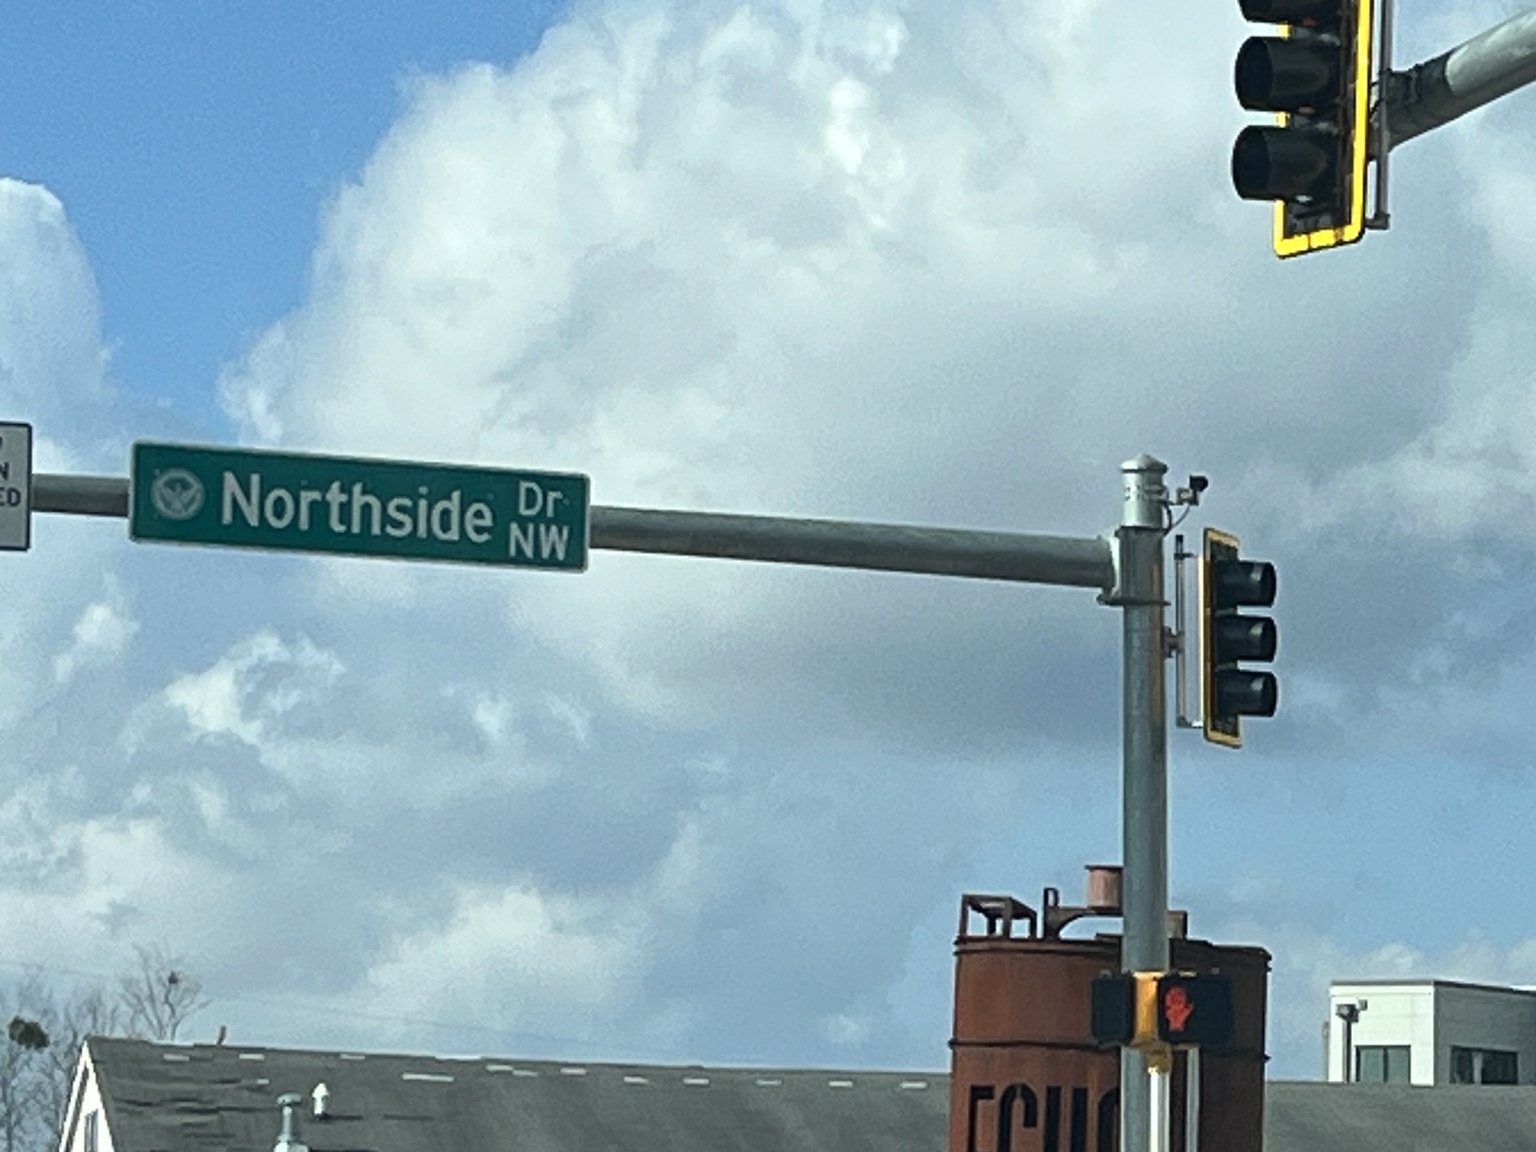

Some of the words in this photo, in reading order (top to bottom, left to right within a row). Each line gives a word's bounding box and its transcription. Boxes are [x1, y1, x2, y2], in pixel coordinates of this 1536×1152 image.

[222, 471, 494, 543] Northside
[518, 480, 564, 518] Dr
[508, 521, 570, 561] NW
